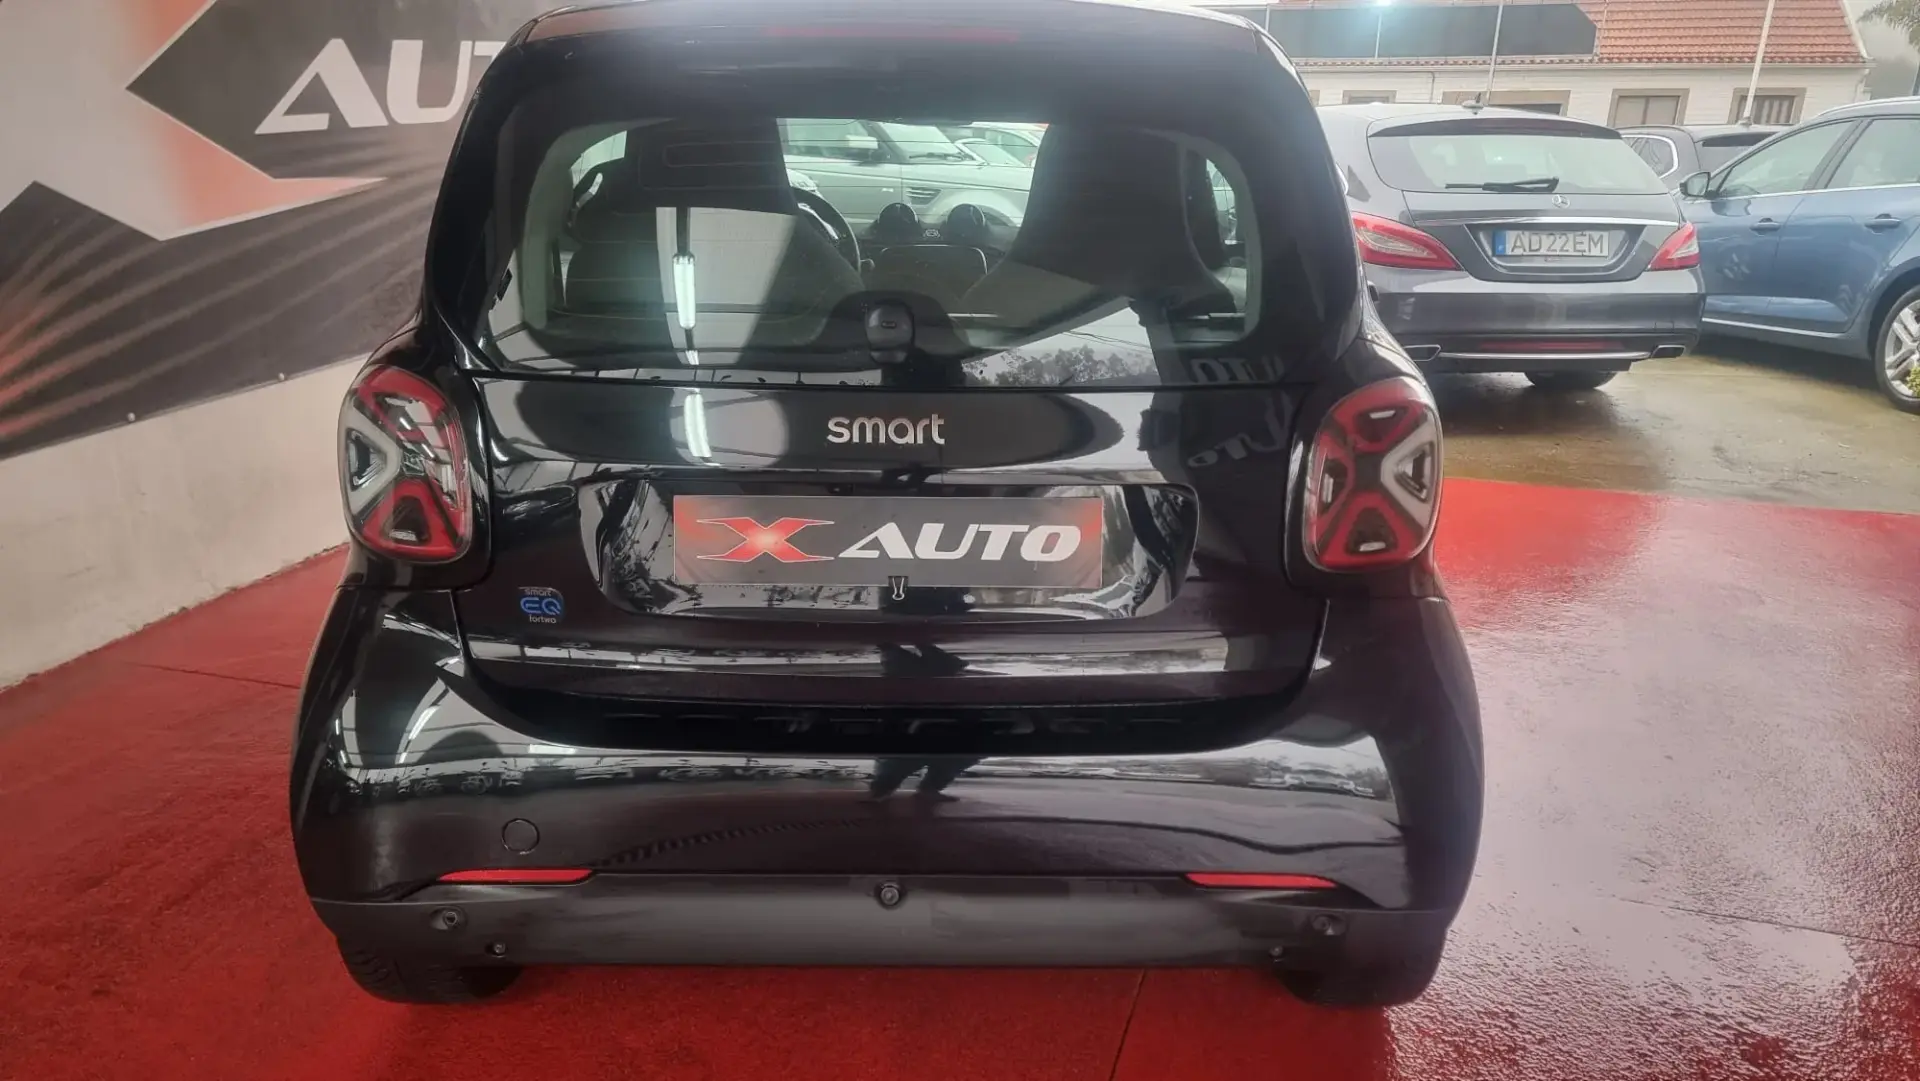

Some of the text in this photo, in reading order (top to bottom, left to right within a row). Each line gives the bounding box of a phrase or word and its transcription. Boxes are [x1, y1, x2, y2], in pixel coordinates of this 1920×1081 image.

[826, 413, 945, 444] smart
[838, 521, 1081, 561] AUTO
[524, 588, 552, 597] smart
[520, 597, 561, 615] EQ
